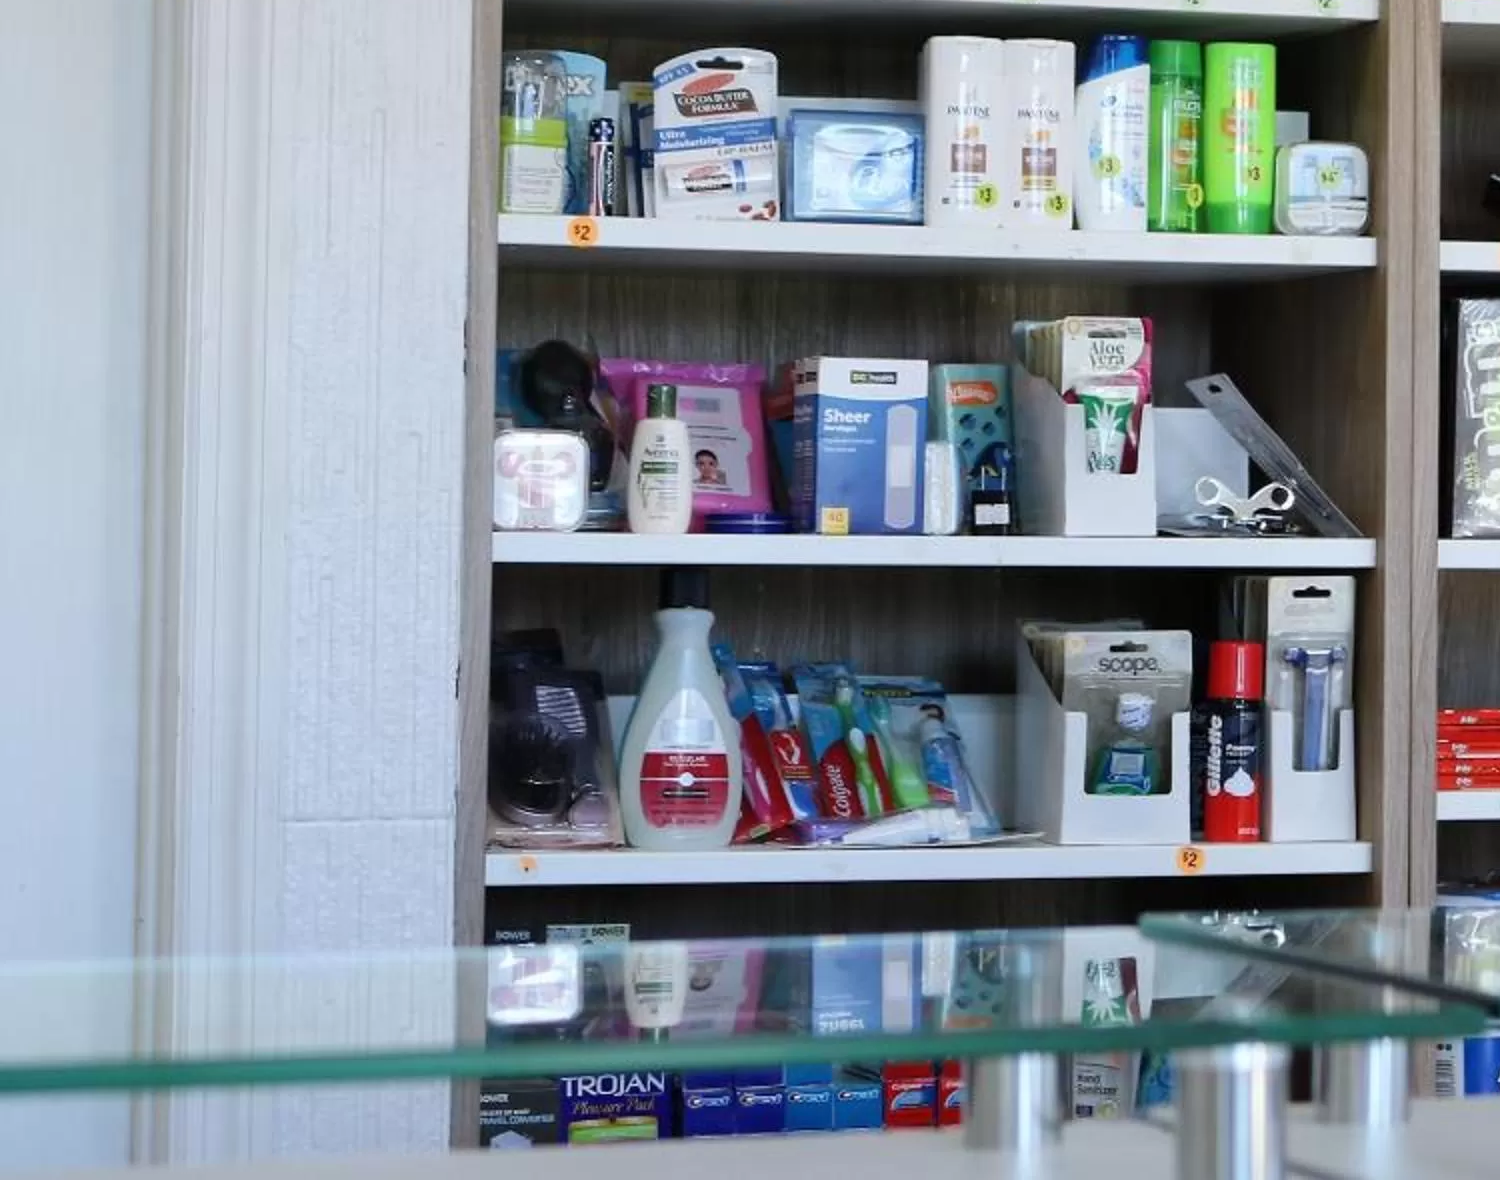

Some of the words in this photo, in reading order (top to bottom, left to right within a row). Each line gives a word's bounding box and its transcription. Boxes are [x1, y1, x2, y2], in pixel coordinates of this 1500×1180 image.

[573, 223, 591, 241] $2
[1089, 340, 1125, 356] Aloe
[1089, 354, 1125, 369] Vera
[824, 408, 871, 426] Sheer
[1206, 713, 1223, 797] Gillette
[826, 763, 853, 818] Colgate
[1183, 851, 1199, 868] $2
[562, 1073, 666, 1098] TROJAN
[626, 1093, 657, 1114] Pack
